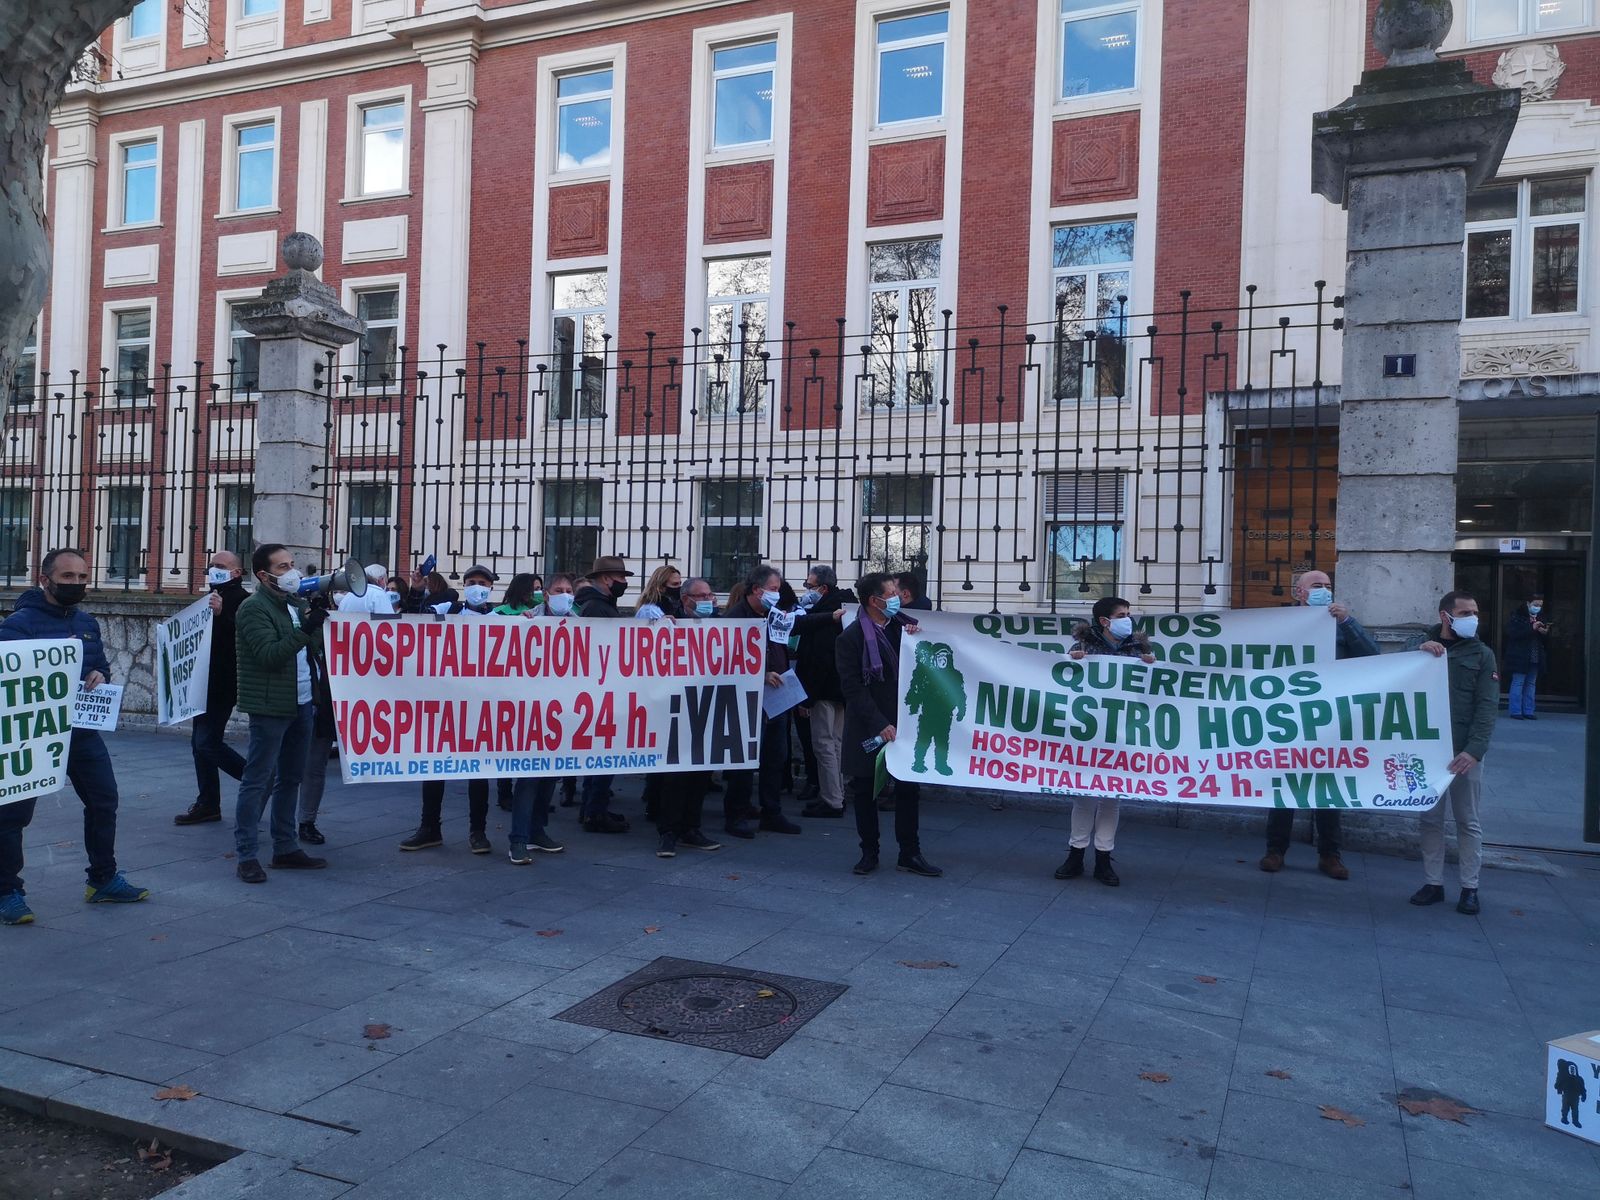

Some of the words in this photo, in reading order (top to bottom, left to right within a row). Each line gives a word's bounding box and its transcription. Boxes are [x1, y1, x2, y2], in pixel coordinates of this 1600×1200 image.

[1396, 357, 1403, 374] 1
[168, 619, 180, 642] YO
[183, 614, 200, 635] LUCHO
[973, 613, 1222, 638] QUERMOS
[33, 645, 77, 669] POR
[330, 618, 590, 678] HOSPITALIZACIÓN
[598, 645, 611, 686] y
[619, 626, 761, 678] URGENCIAS
[1, 671, 69, 708] TRO
[172, 656, 197, 686] HOSP
[1051, 661, 1322, 701] QUEREMOS
[1, 705, 72, 745] ITAL
[333, 699, 563, 756] HOSPITALARIAS
[571, 691, 617, 750] 24
[626, 692, 657, 749] h.
[666, 685, 759, 765] ¡YA!
[975, 681, 1181, 750] NUESTRO
[1197, 692, 1440, 750] HOSPITAL
[47, 741, 64, 768] ?
[408, 760, 429, 775] DE
[433, 756, 481, 774] BÉJAR
[495, 757, 551, 772] VIRGEN
[554, 756, 582, 770] DEL
[971, 730, 1190, 775] HOSPITALIZACIÓN
[1197, 758, 1209, 774] y
[1216, 747, 1370, 771] URGENCIAS
[968, 756, 1169, 797] HOSPITALARIAS
[1176, 774, 1221, 799] 24
[1230, 773, 1263, 798] h.
[1271, 772, 1364, 809] ¡YA!
